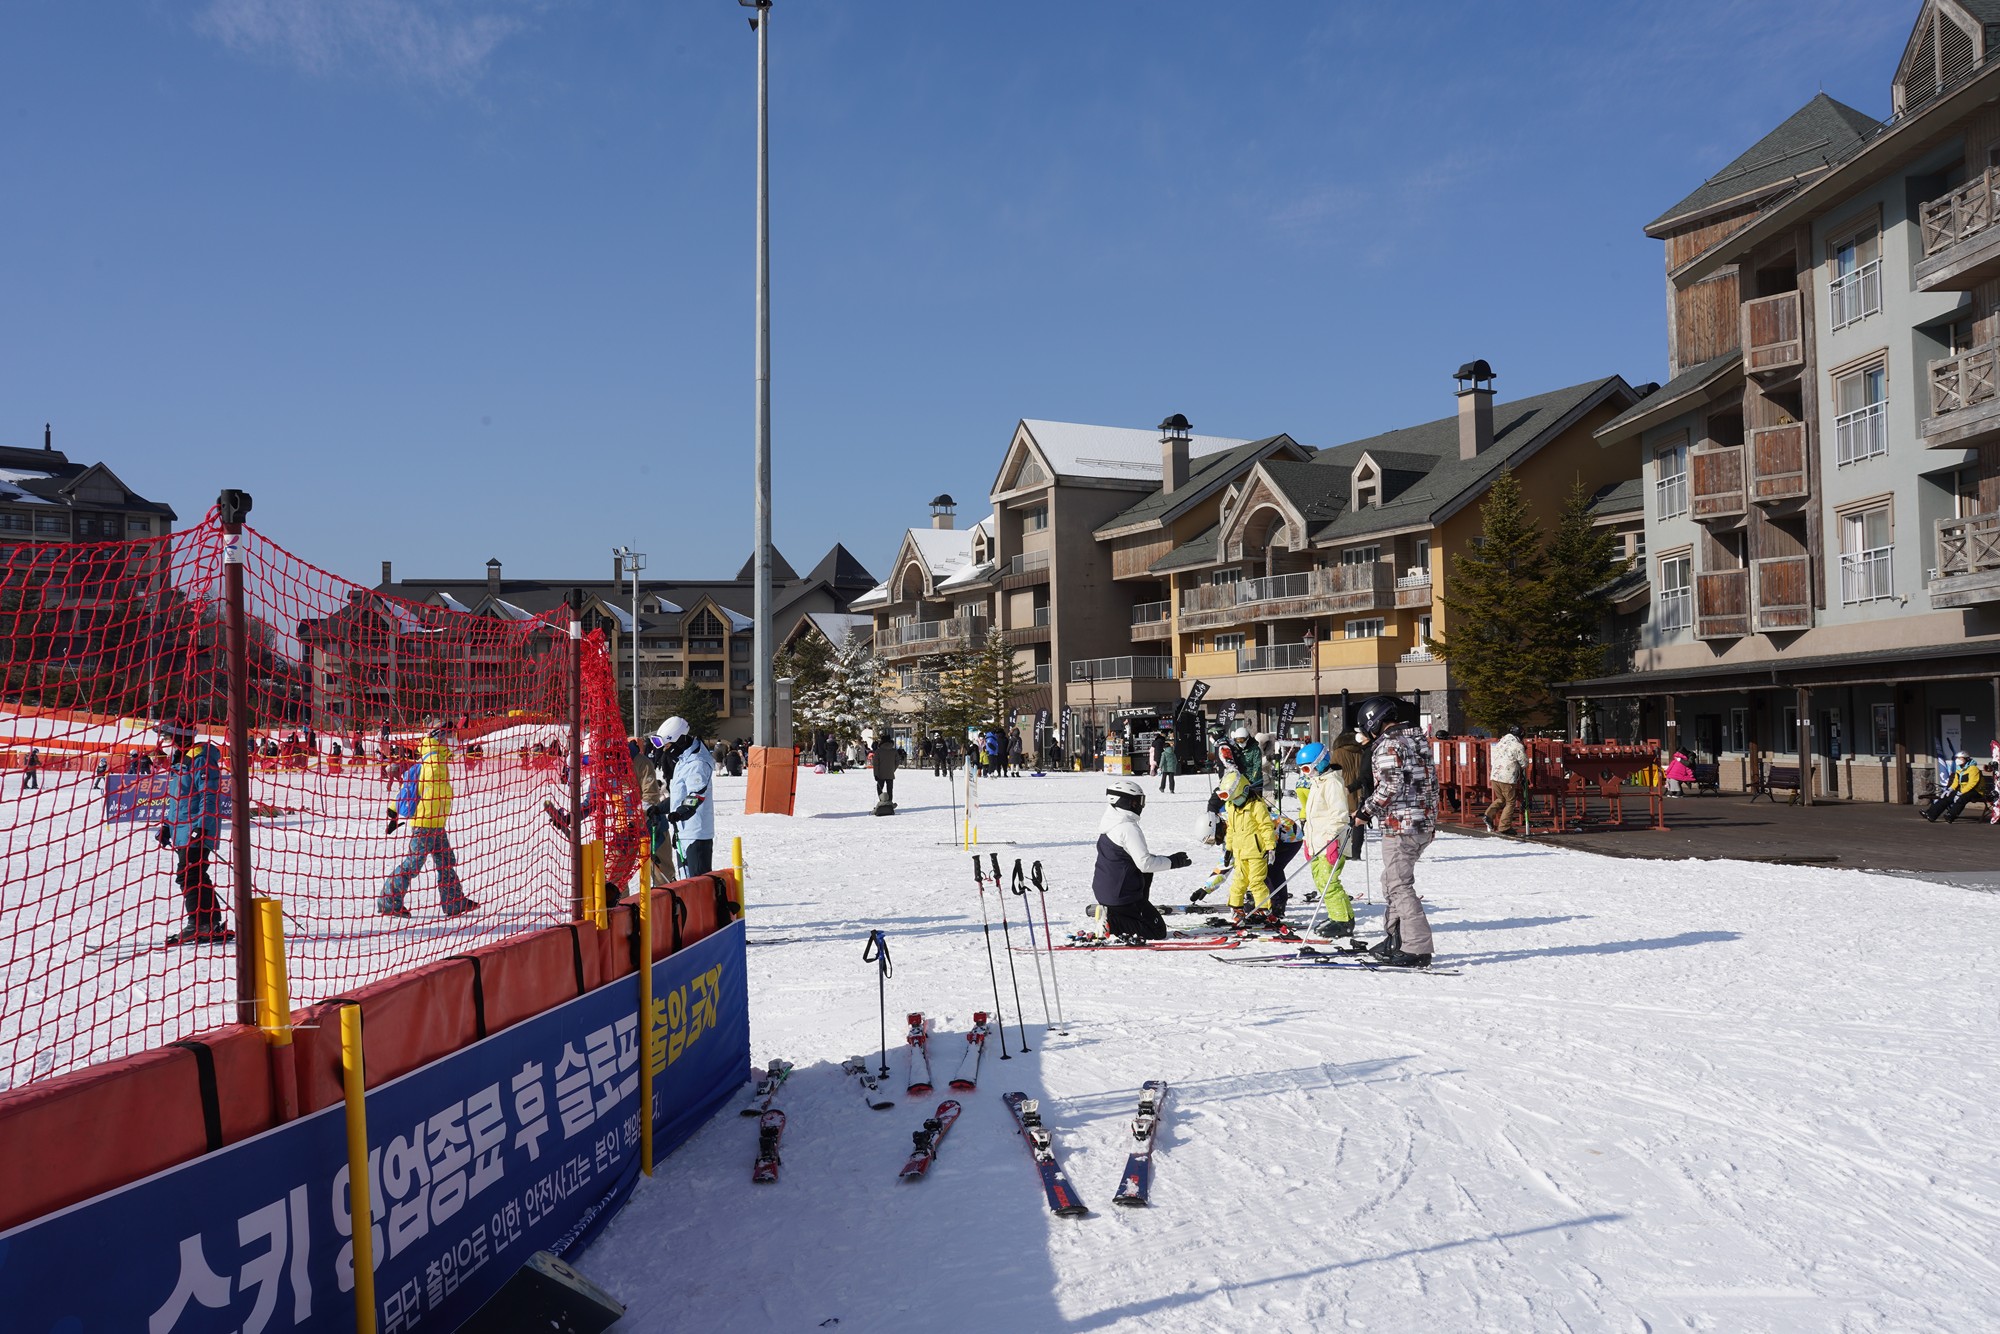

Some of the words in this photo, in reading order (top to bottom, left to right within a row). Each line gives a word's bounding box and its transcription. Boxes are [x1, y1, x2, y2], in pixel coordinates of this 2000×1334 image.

[149, 1183, 312, 1334] 스키
[332, 1081, 507, 1293] 영업종료
[512, 1061, 549, 1162] 후
[554, 1011, 639, 1140] 슬로프
[383, 1276, 422, 1334] 무단
[426, 1224, 490, 1312] 출입으로
[491, 1209, 523, 1255] 인한
[525, 1153, 591, 1228] 안전사고는
[595, 1127, 621, 1174] 본인
